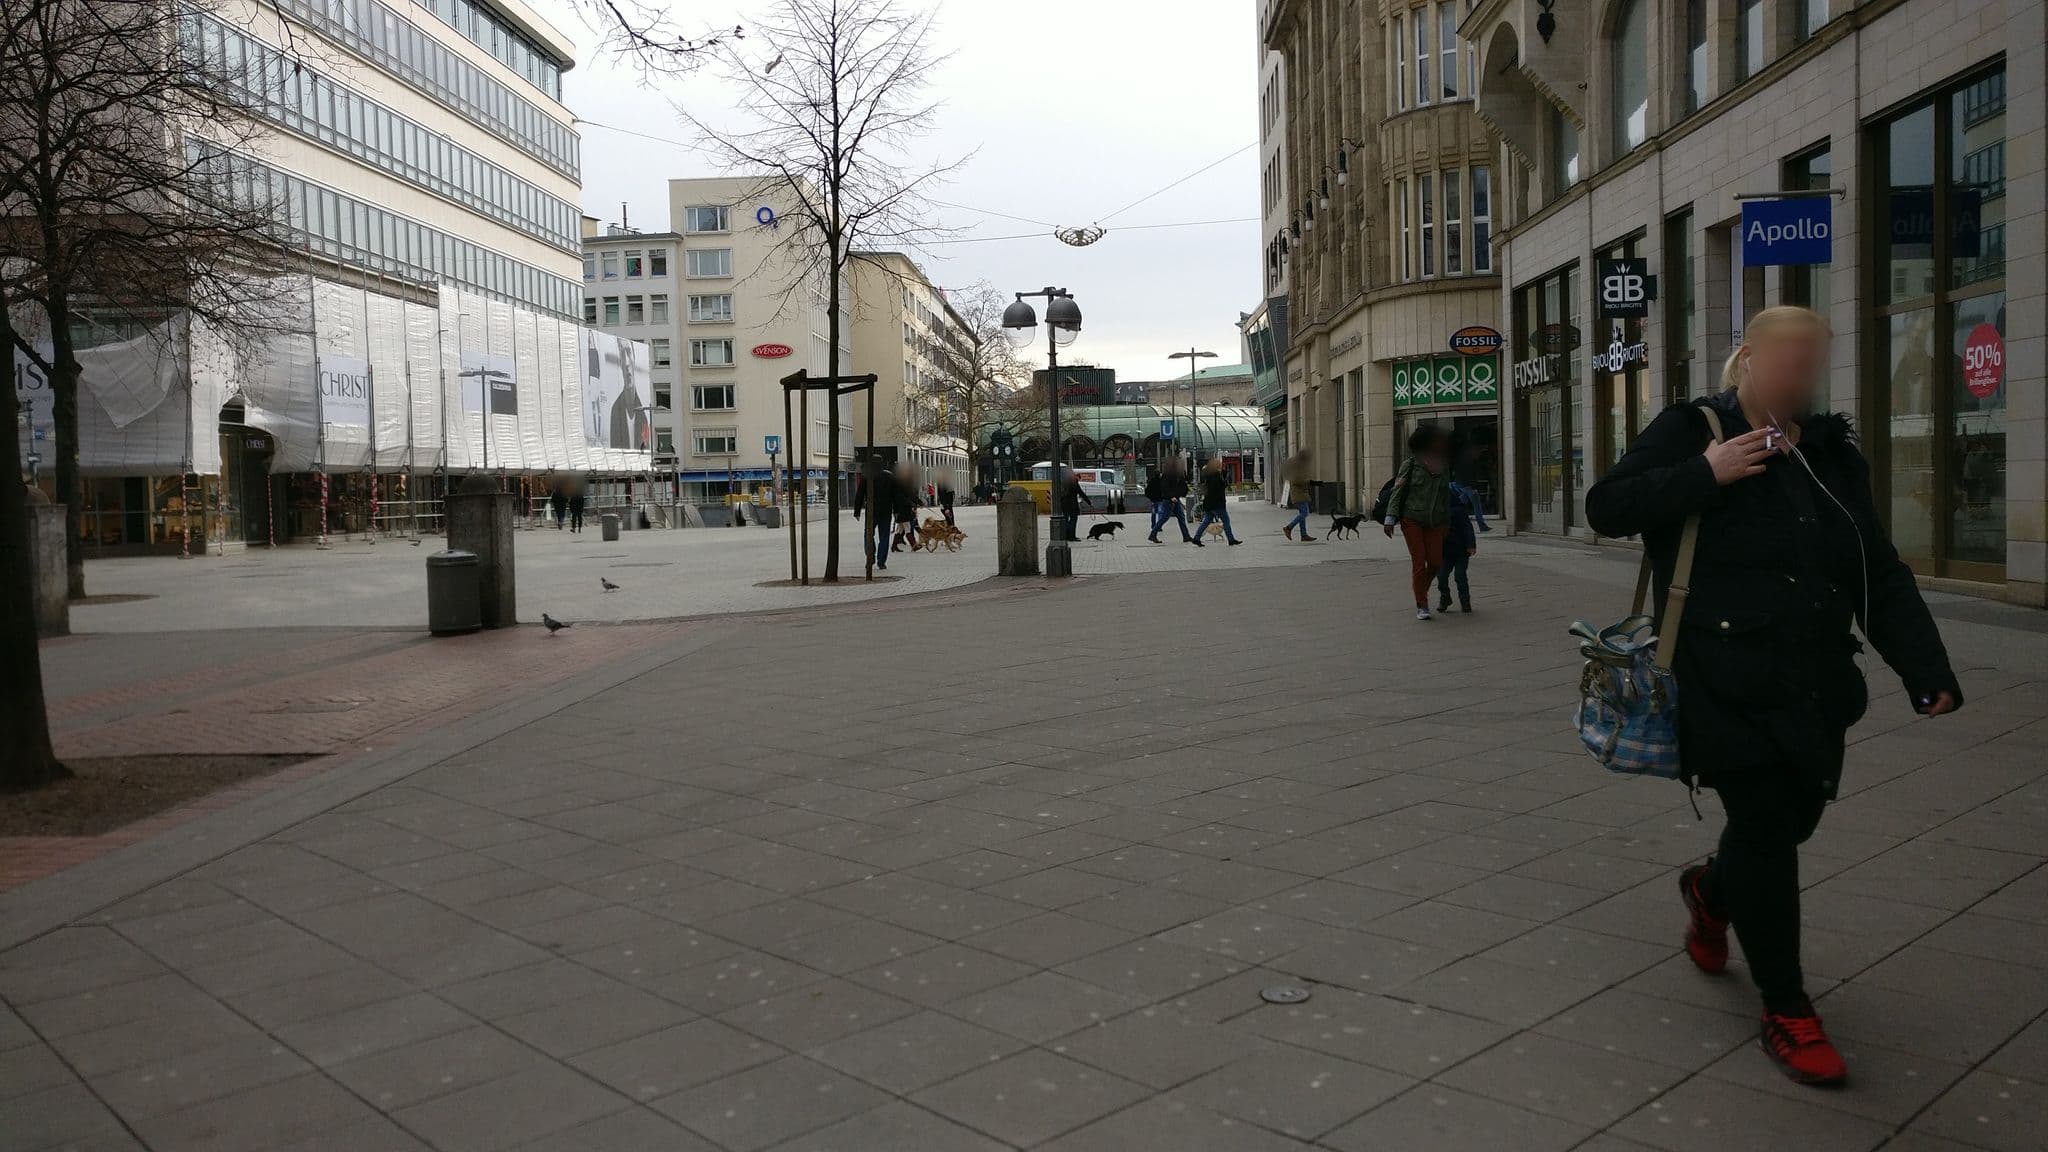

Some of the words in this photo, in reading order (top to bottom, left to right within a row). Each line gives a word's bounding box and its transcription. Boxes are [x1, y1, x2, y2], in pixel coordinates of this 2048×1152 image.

[1747, 217, 1828, 247] Apollo
[1456, 336, 1497, 346] FOSSIL
[1966, 343, 2001, 370] 50%
[320, 370, 369, 399] CHRIST
[1515, 355, 1550, 388] FOSSIL
[1162, 424, 1173, 437] U
[766, 440, 777, 451] U
